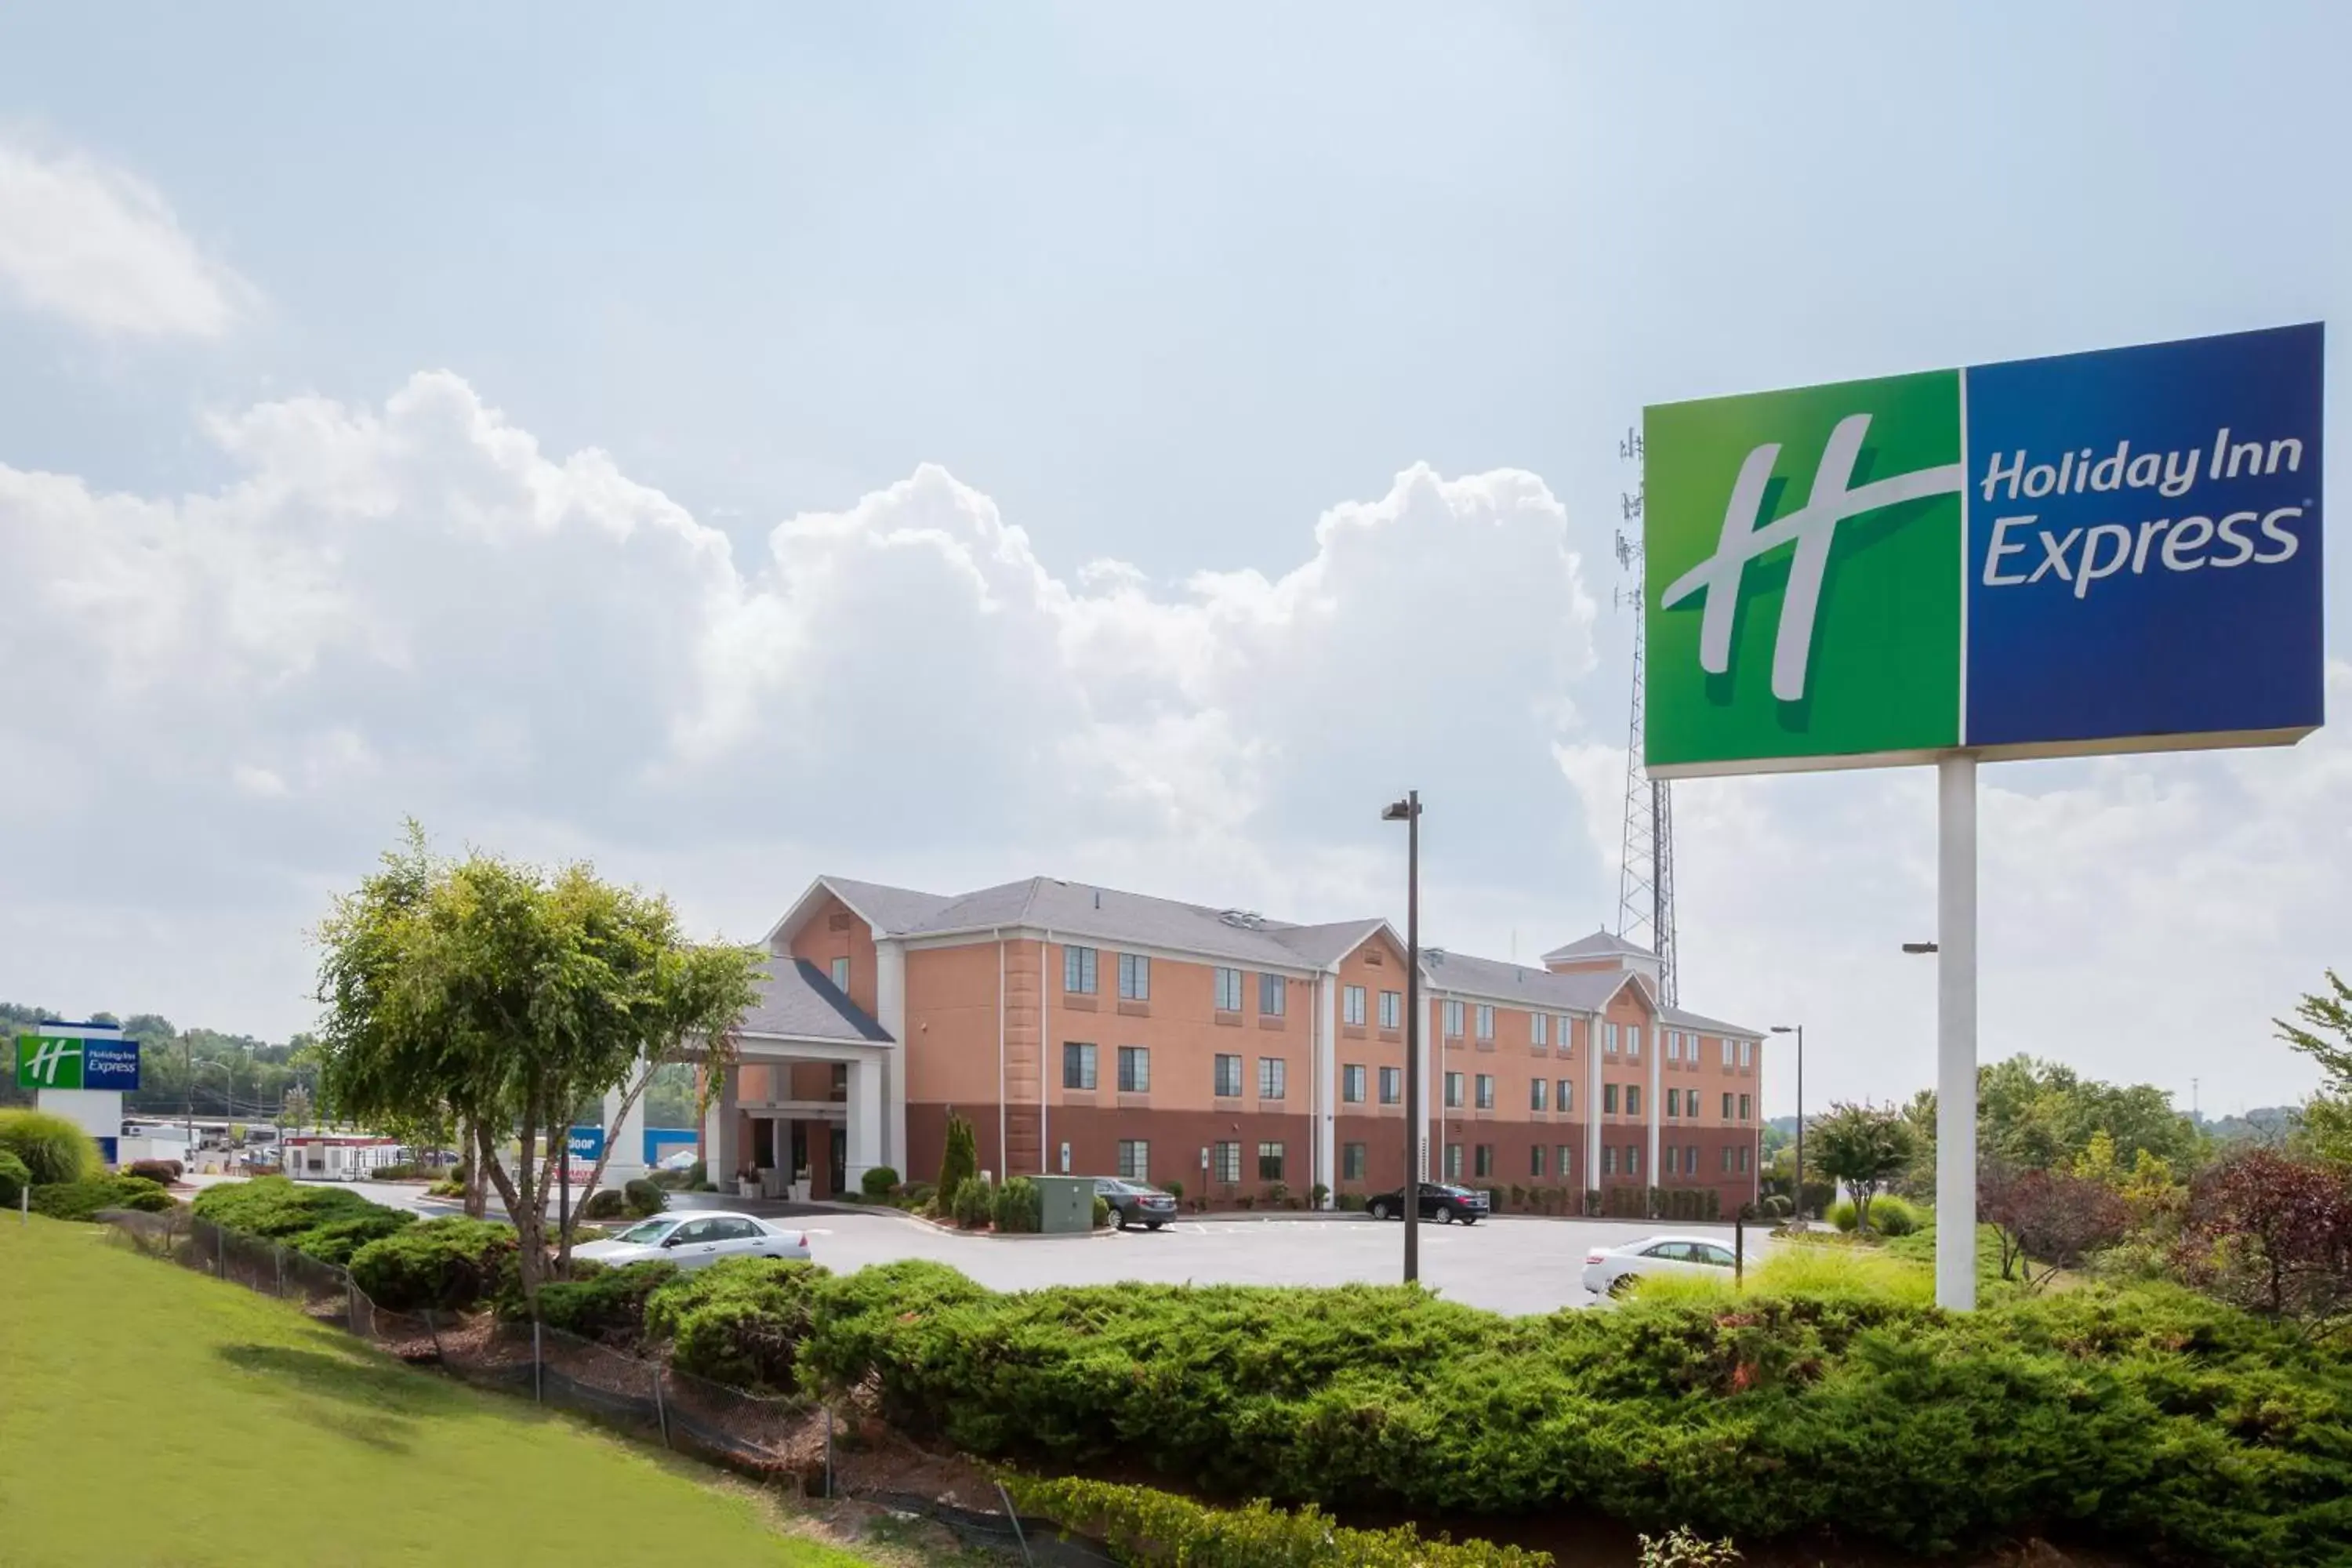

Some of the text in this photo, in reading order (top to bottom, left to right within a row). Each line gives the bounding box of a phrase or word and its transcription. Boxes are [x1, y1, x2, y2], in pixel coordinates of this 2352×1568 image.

[1980, 427, 2303, 503] Holiday Inn
[1982, 506, 2303, 600] Express
[89, 1059, 136, 1073] Express
